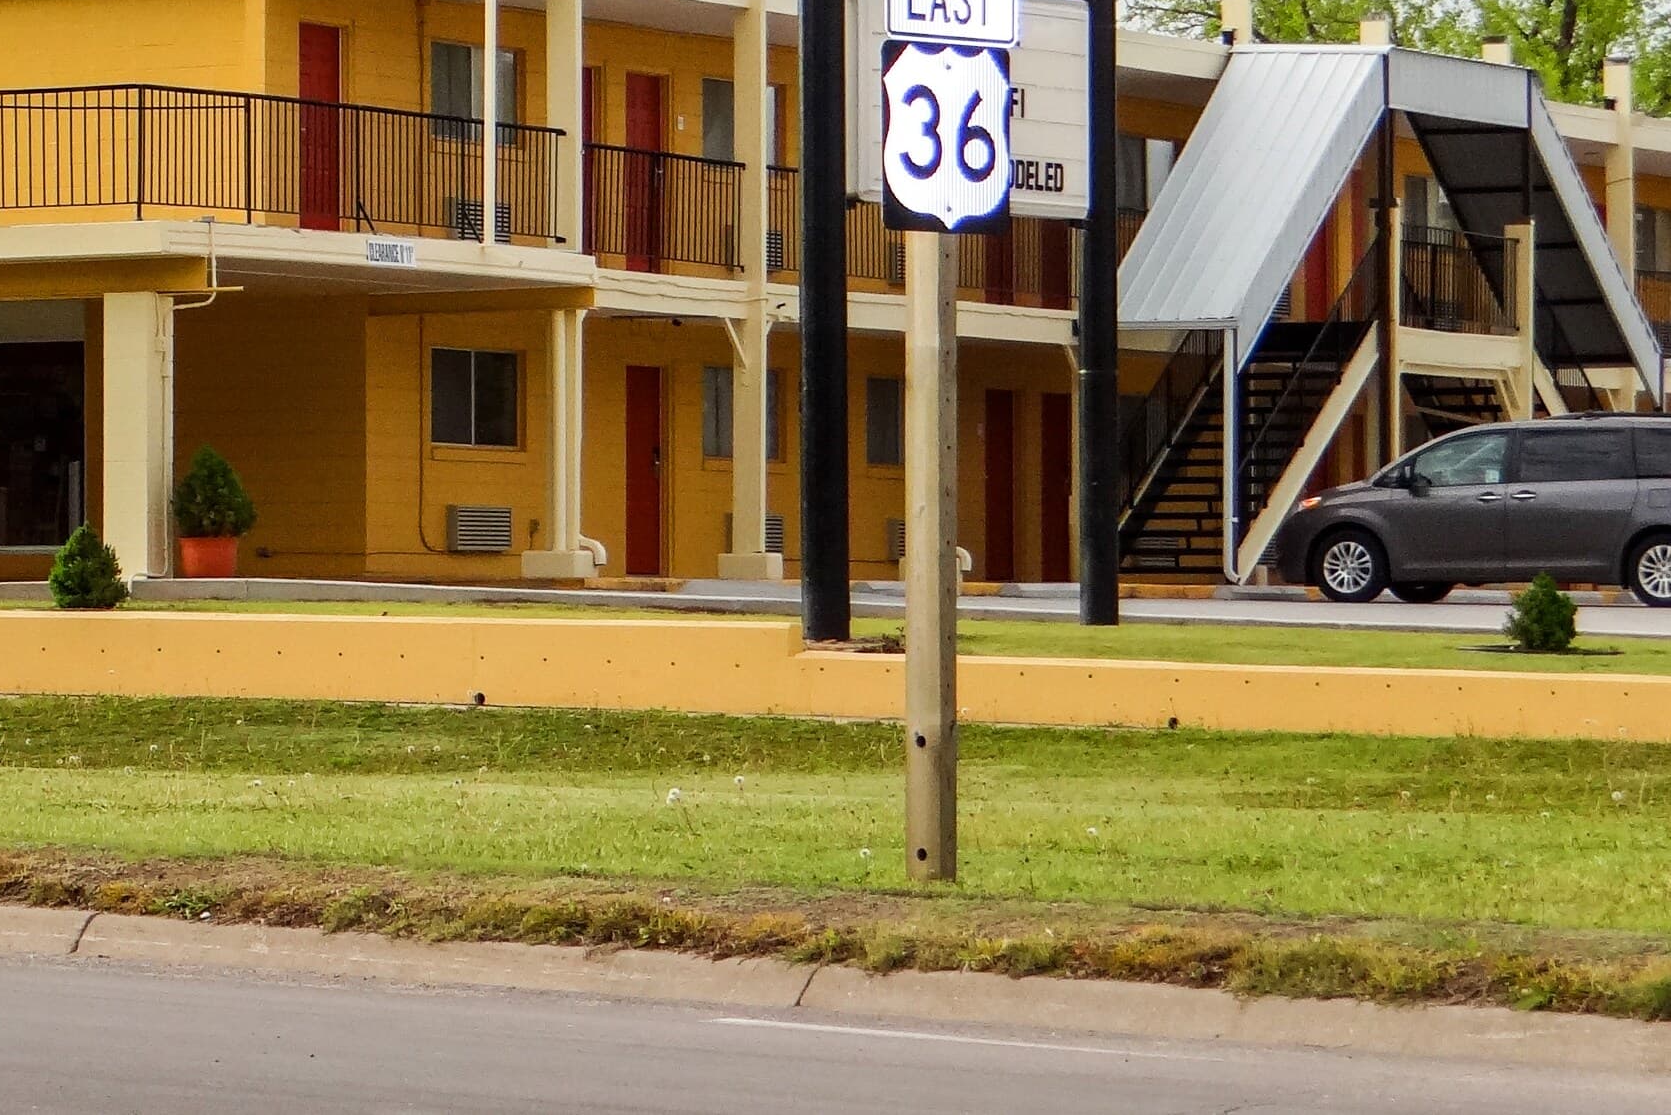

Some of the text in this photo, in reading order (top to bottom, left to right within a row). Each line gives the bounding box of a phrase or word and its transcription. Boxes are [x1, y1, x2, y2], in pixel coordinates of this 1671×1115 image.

[1009, 87, 1025, 118] FI
[899, 83, 997, 183] 36
[1009, 158, 1065, 192] ODELED
